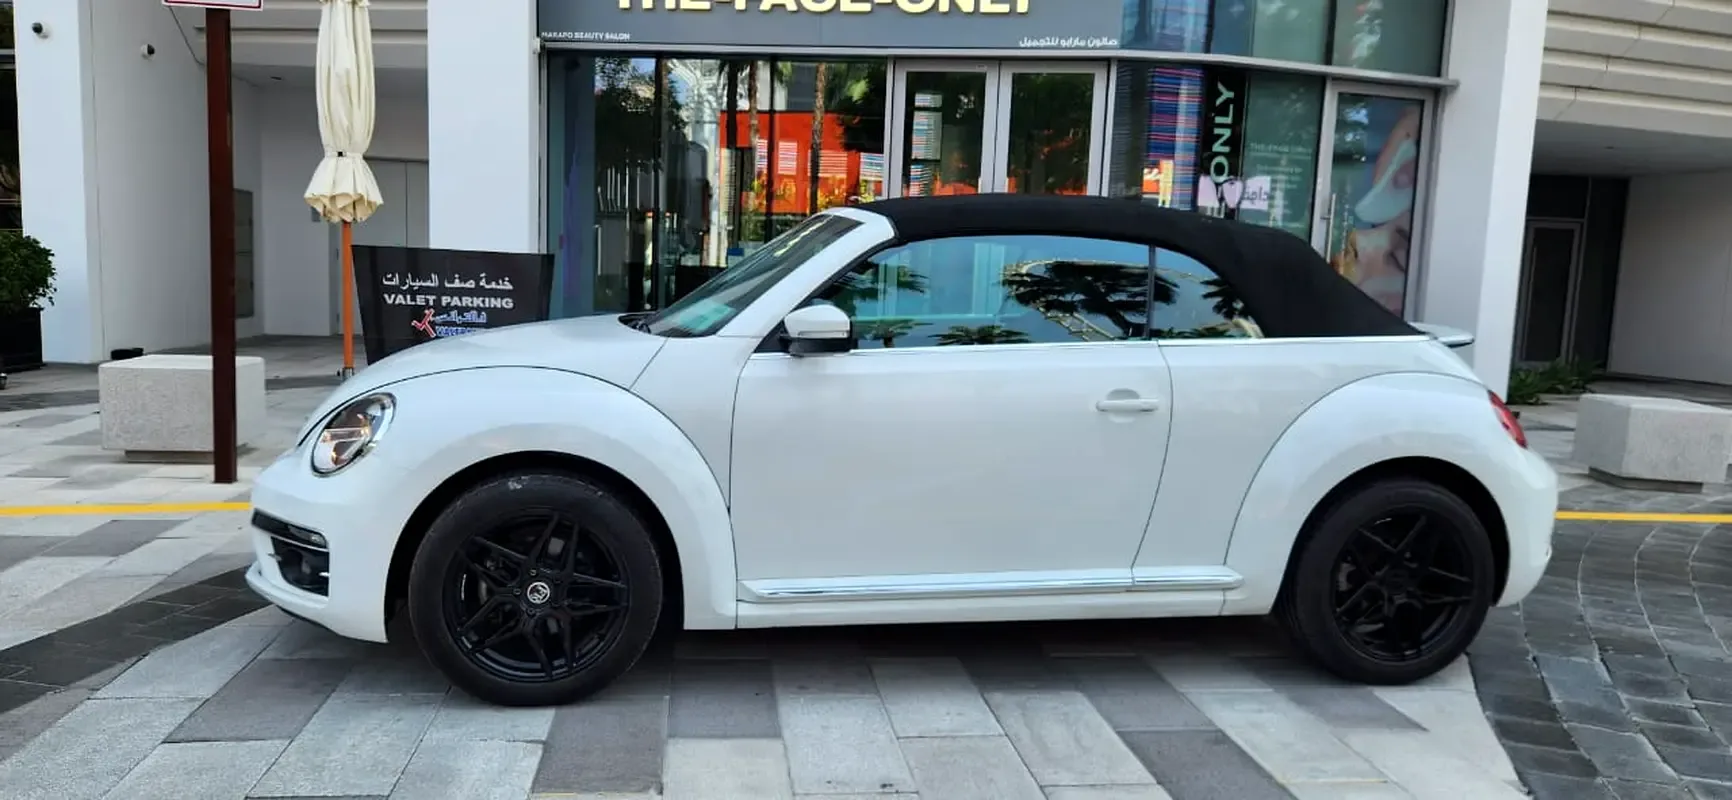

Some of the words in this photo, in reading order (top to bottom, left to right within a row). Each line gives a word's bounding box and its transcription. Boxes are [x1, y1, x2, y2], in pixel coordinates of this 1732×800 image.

[574, 31, 604, 39] BEAUTY
[605, 32, 630, 40] SALON
[1019, 36, 1060, 48] للتجميل
[1087, 36, 1118, 48] صالون
[382, 272, 439, 290] السيارات
[444, 273, 476, 289] صف
[479, 272, 514, 290] خدمة
[383, 293, 437, 306] VALET
[441, 295, 514, 309] PARKING
